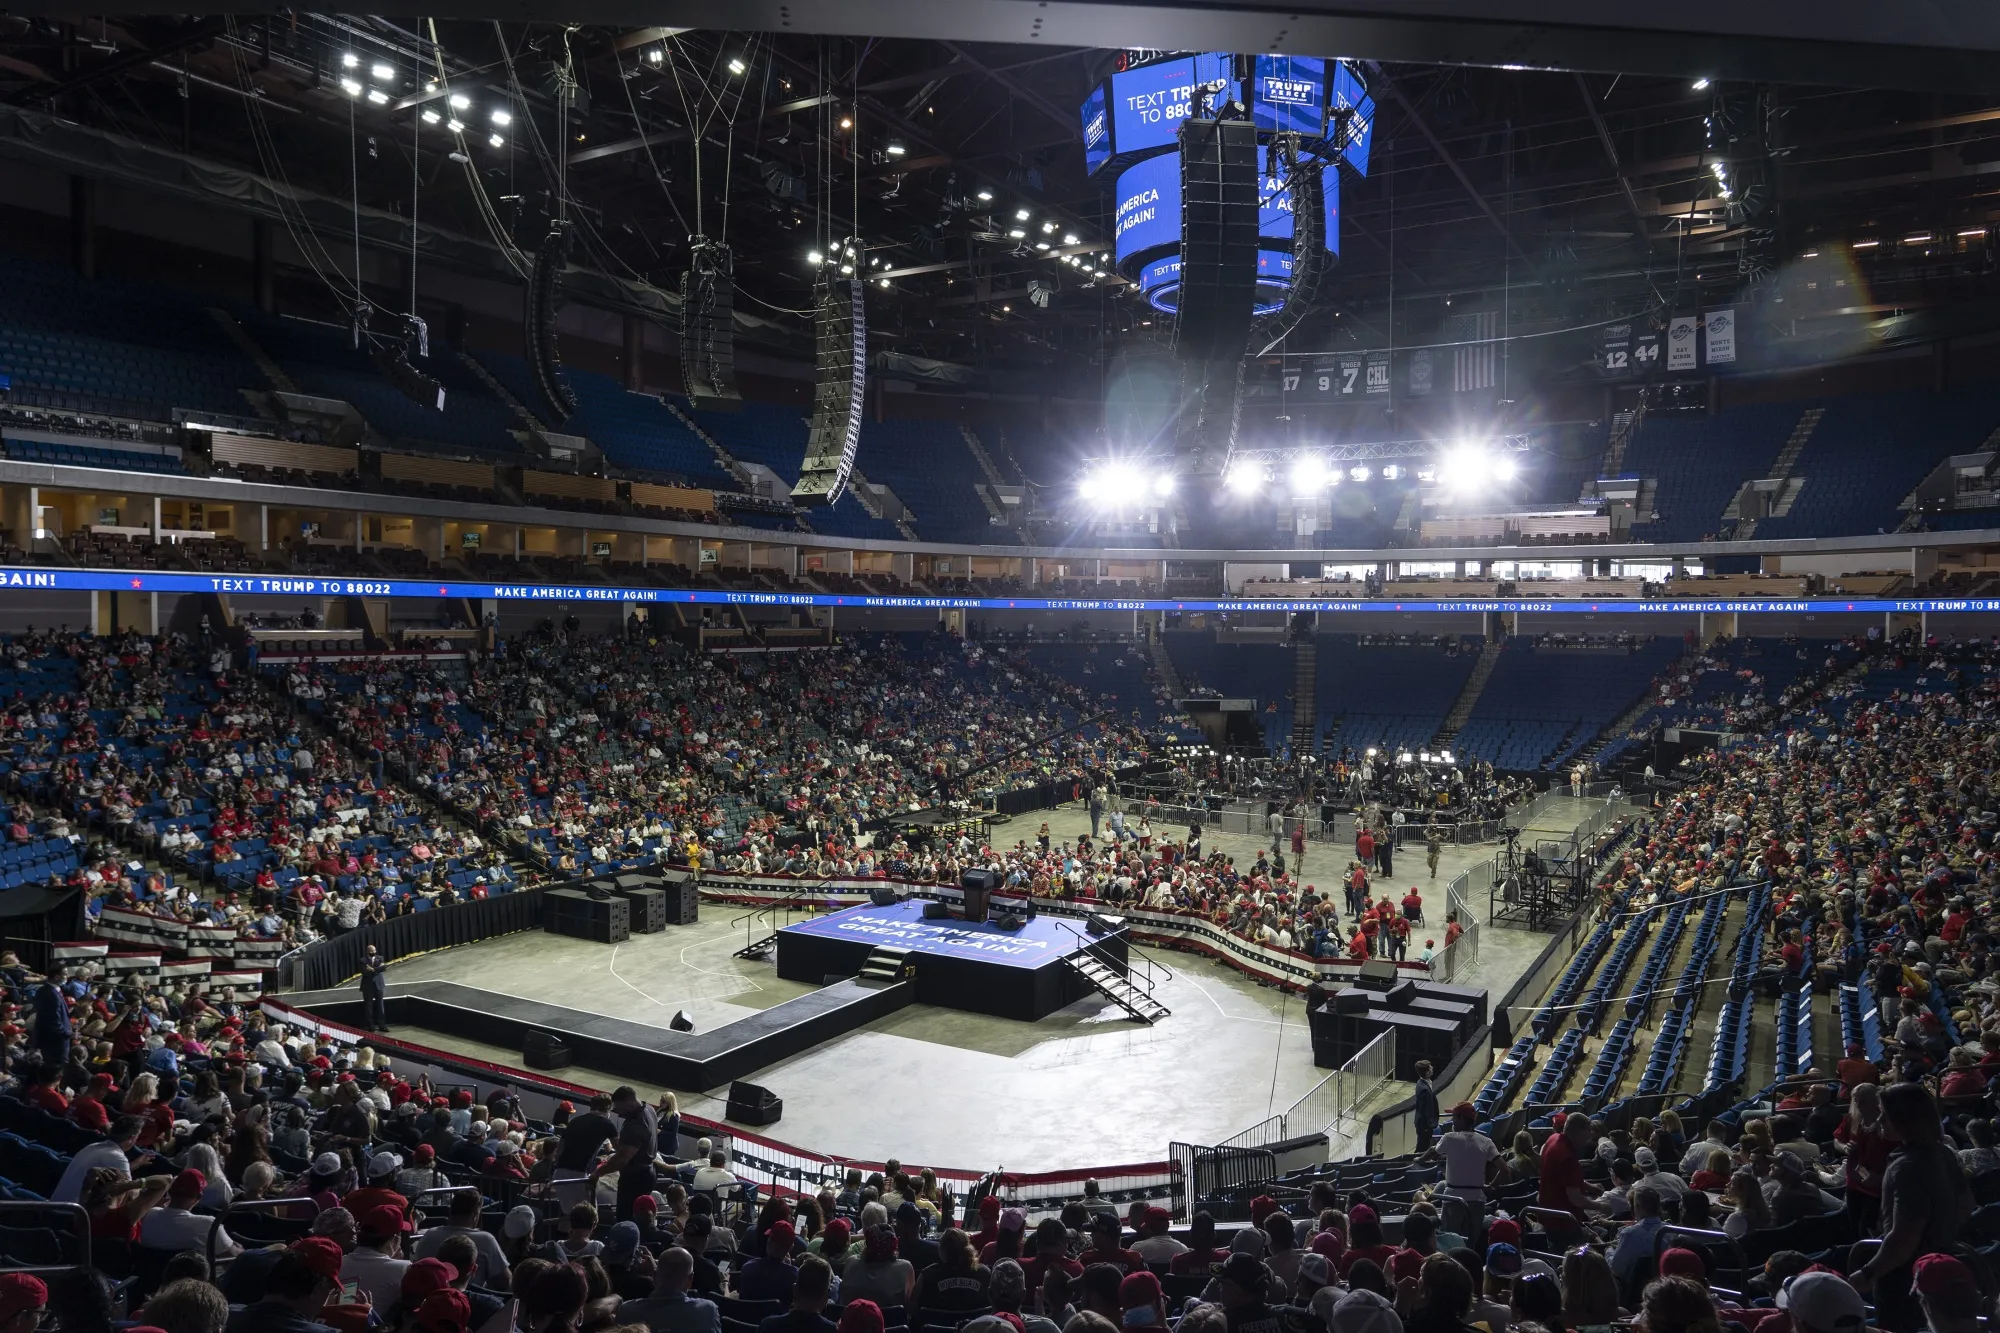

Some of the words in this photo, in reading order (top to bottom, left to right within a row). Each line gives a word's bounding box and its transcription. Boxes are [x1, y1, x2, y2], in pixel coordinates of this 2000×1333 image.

[1267, 80, 1312, 92] TRUMP
[1270, 89, 1307, 98] PENCE
[1127, 91, 1166, 111] TEXT
[1170, 79, 1227, 102] TRP
[1140, 109, 1161, 124] TO
[1119, 188, 1159, 218] AMERICA
[1123, 207, 1155, 232] AGAIN!
[1154, 265, 1169, 277] TEXT
[1606, 351, 1628, 369] 12
[1634, 344, 1659, 361] 44
[1342, 367, 1359, 393] 7
[1366, 365, 1389, 385] CHL
[1283, 375, 1300, 391] 17
[1318, 376, 1330, 391] 9
[211, 578, 254, 592] TEXT
[260, 580, 315, 593] TRUMP
[321, 581, 341, 593] TO
[346, 582, 391, 594] 88022
[494, 587, 527, 597] MAKE
[532, 588, 582, 598] AMERICA
[586, 589, 619, 599] GREAT
[623, 591, 657, 600] AGAIN!
[727, 593, 747, 602] TEXT
[750, 594, 776, 603] TRUMP
[779, 595, 789, 603] TO
[791, 595, 813, 604] 88022
[1895, 602, 1925, 610] TEXT
[1929, 602, 1967, 610] TRUMP
[1970, 601, 1984, 610] TO
[1327, 603, 1361, 611] AGAIN!
[1436, 603, 1462, 611] TEXT
[1465, 603, 1499, 611] TRUMP
[1502, 603, 1517, 611] TO
[1520, 603, 1552, 611] 88022
[1639, 603, 1668, 611] MAKE
[1672, 603, 1722, 611] AMERICA
[1726, 603, 1764, 611] GREAT
[1768, 603, 1809, 611] AGAIN!
[838, 923, 928, 939] GREAT
[931, 936, 1029, 955] AGAIN!
[847, 915, 925, 931] MAKE
[931, 927, 1048, 949] AMERICA
